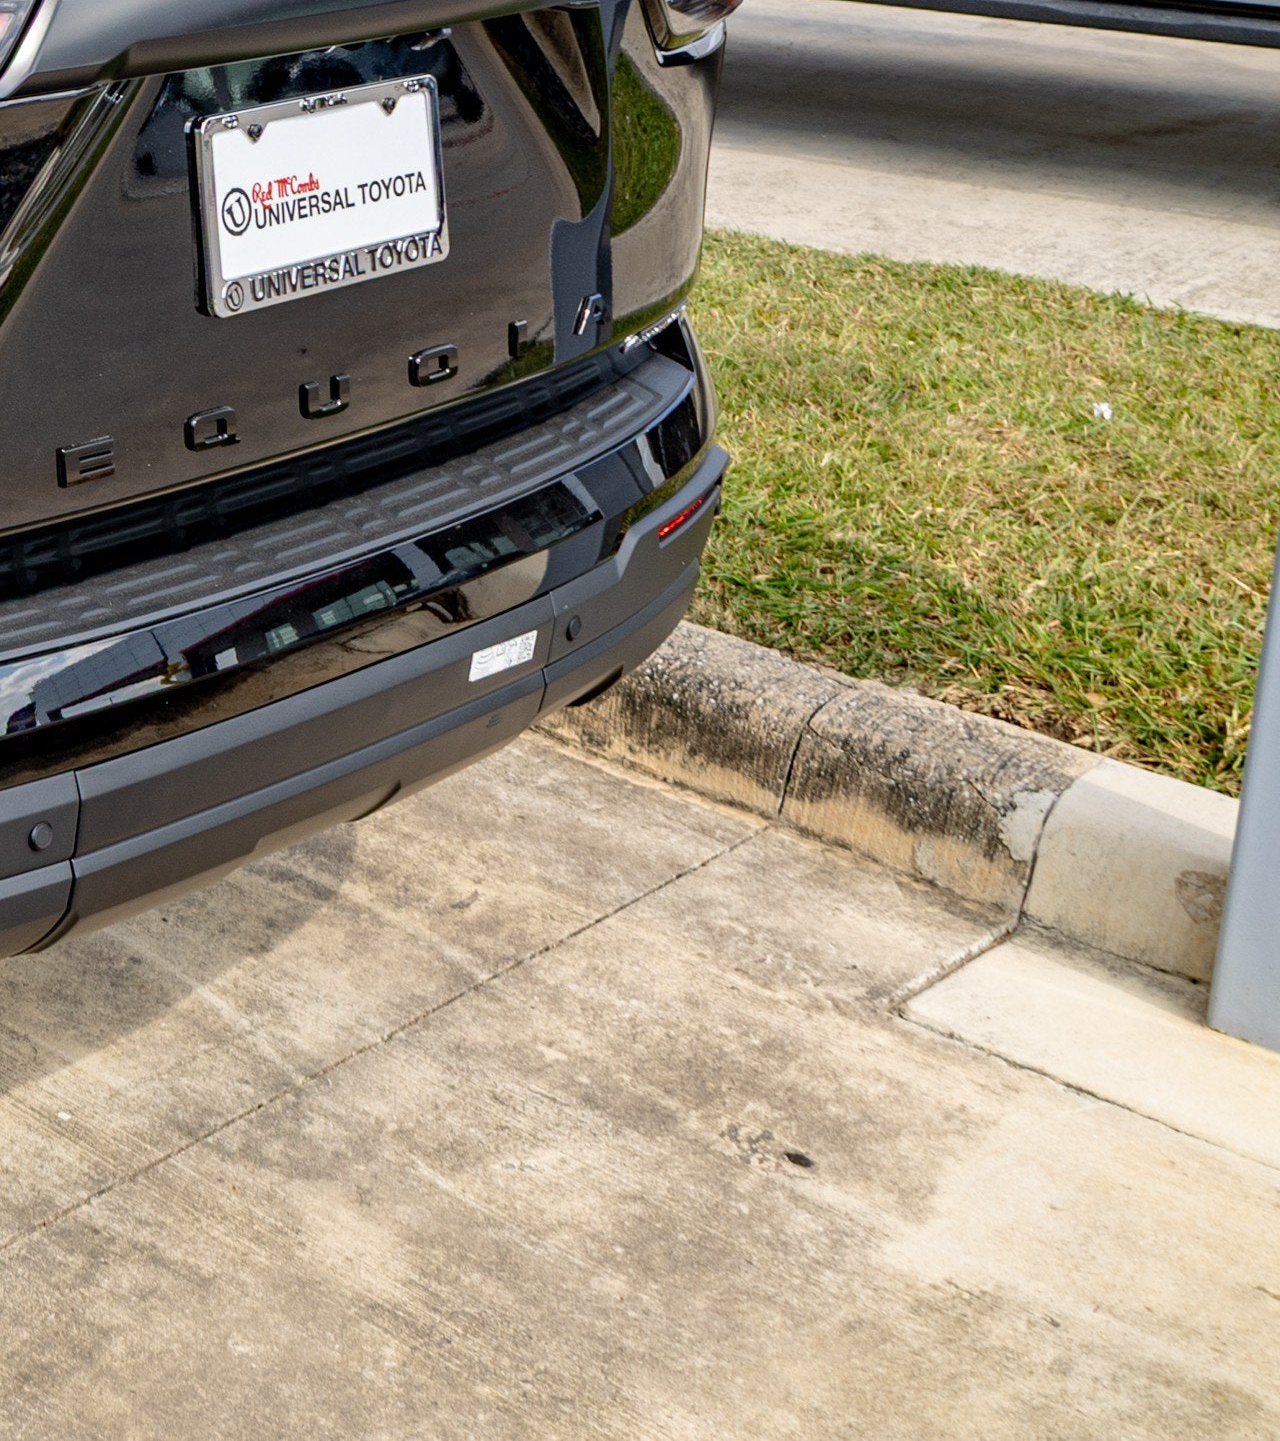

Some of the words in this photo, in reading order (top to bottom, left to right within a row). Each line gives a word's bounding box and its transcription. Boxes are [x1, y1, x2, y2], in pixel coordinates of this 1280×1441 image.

[252, 181, 274, 210] Red
[254, 188, 355, 229] UNIVERSAL
[357, 171, 427, 205] TOYOTA
[249, 252, 366, 302] UNIVERSAL
[365, 234, 443, 270] TOYOTA
